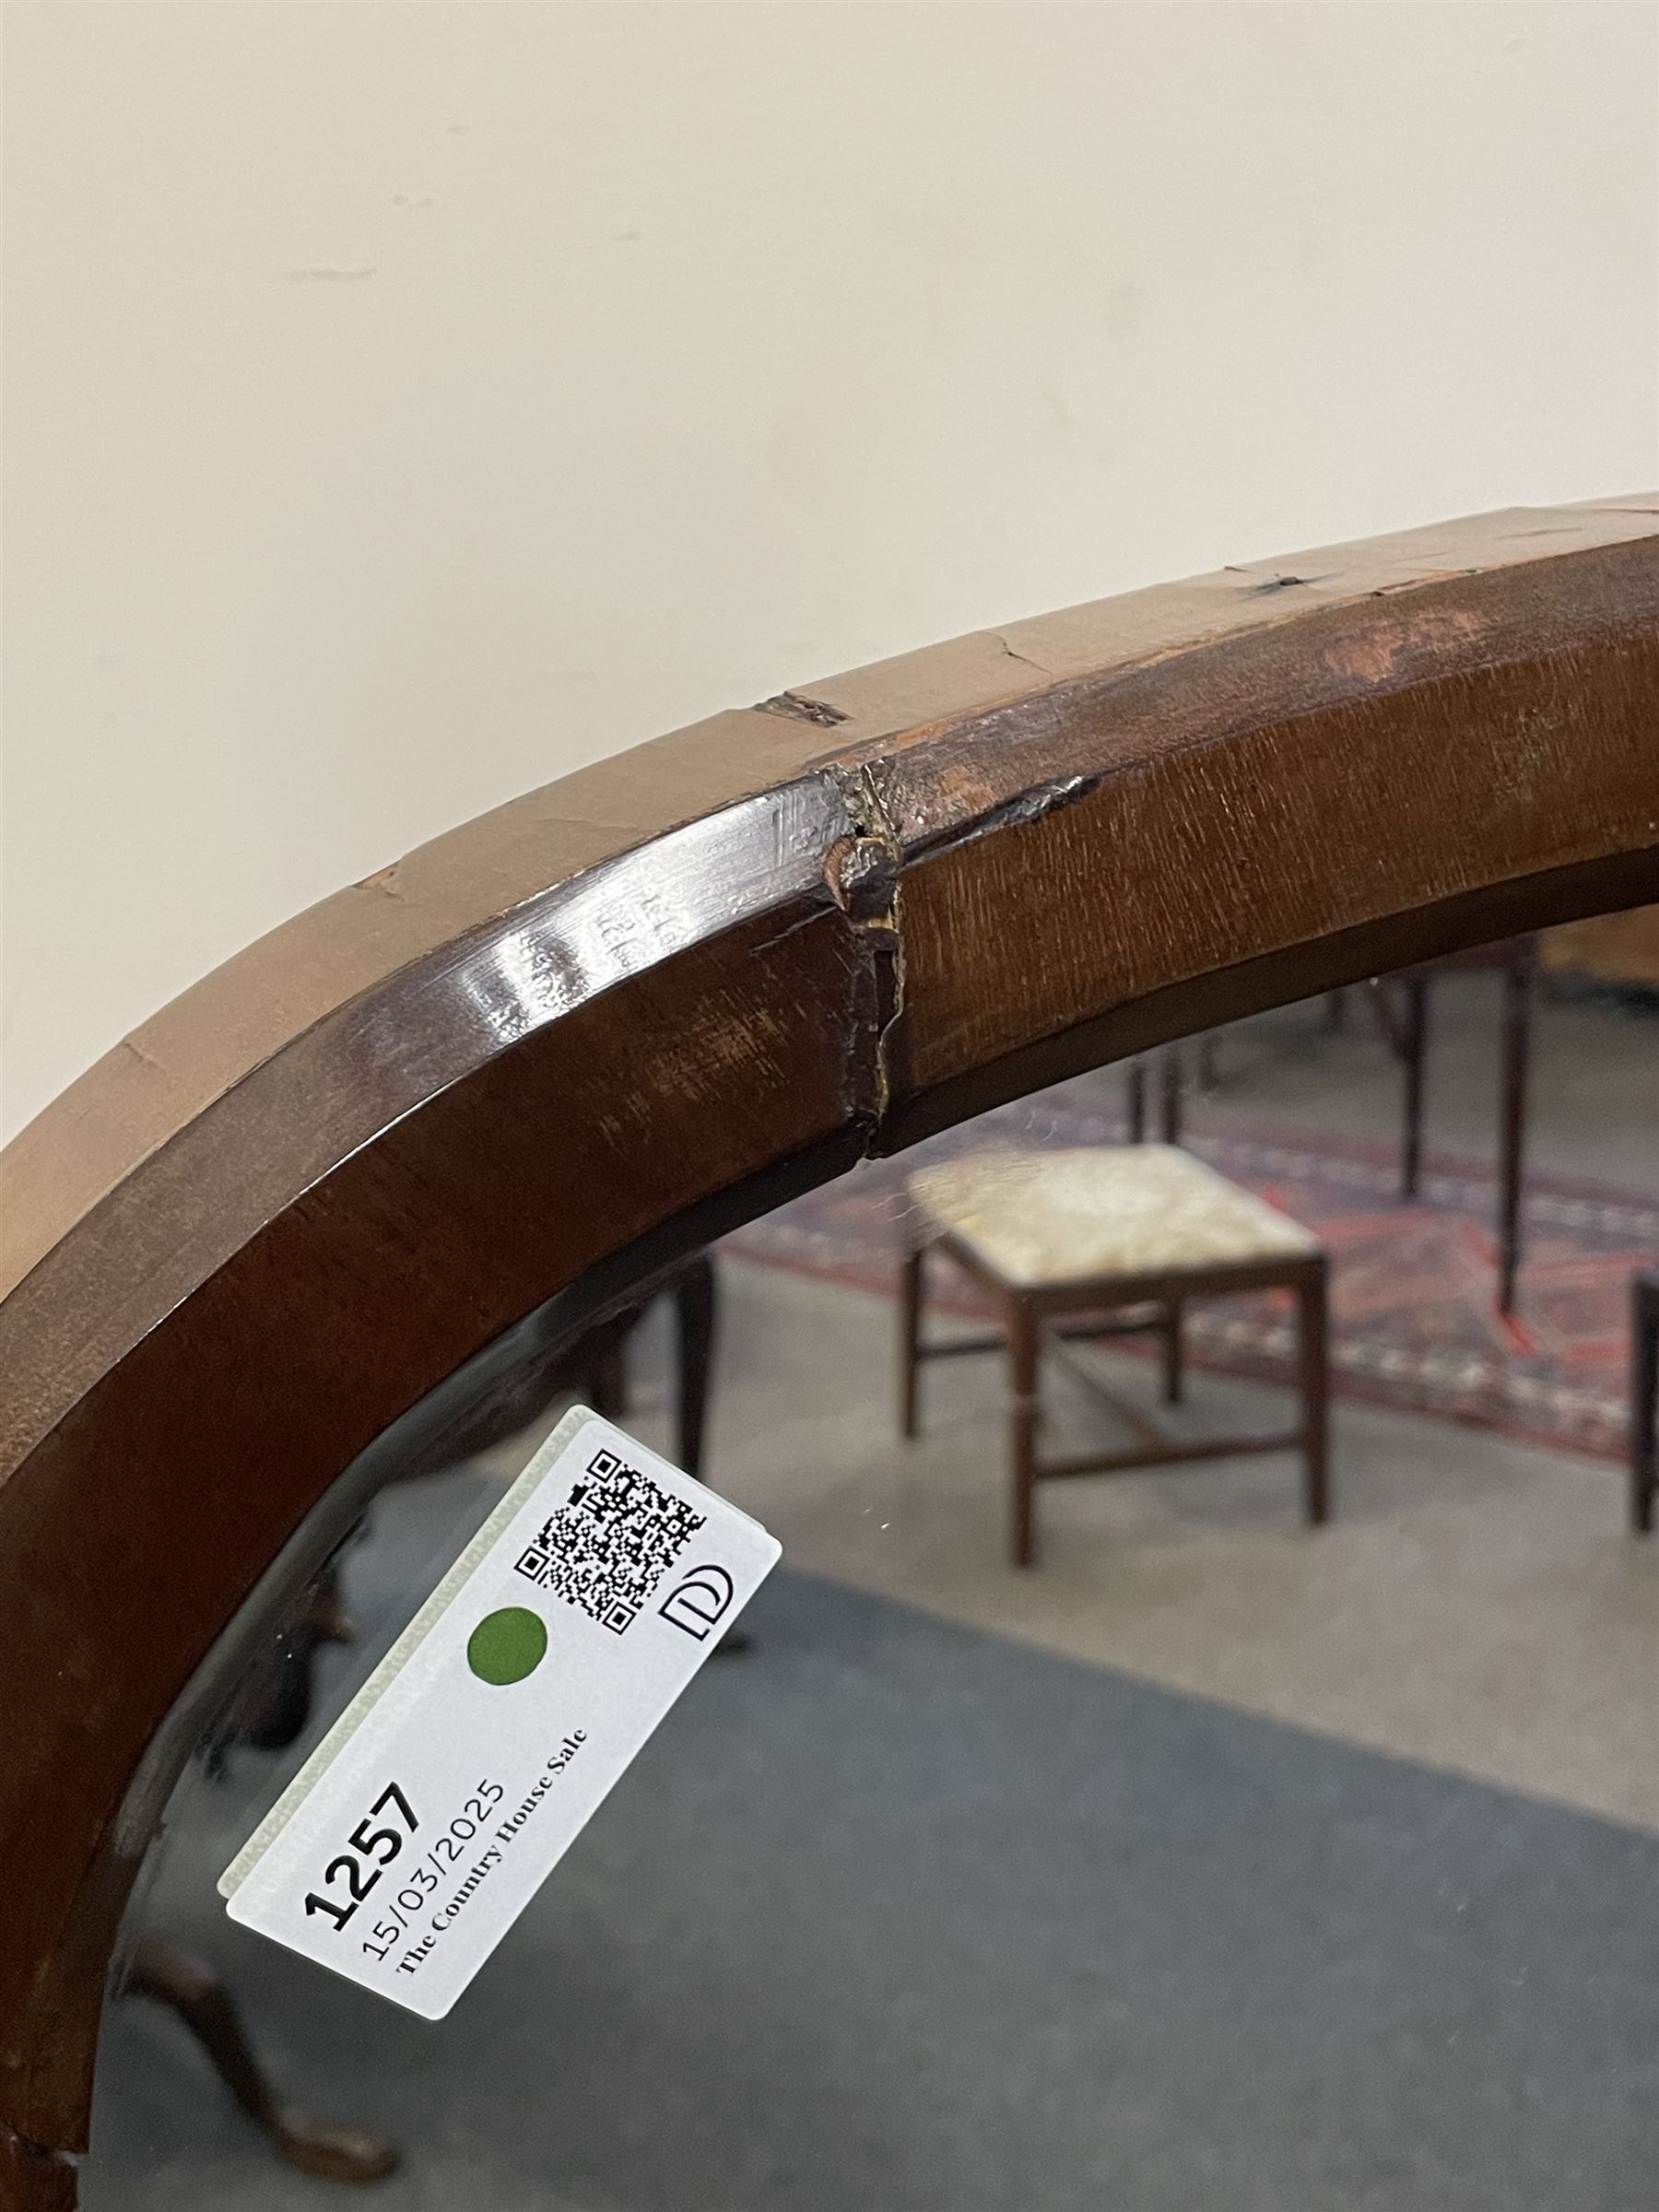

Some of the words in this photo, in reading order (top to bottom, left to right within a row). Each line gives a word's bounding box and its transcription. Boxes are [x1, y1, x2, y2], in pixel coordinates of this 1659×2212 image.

[304, 1781, 419, 1933] 1257
[362, 1778, 505, 1962] 15/03/2025
[395, 1935, 437, 1975] The
[431, 1844, 503, 1932] Country
[495, 1775, 553, 1843] House
[547, 1728, 588, 1775] Sale
